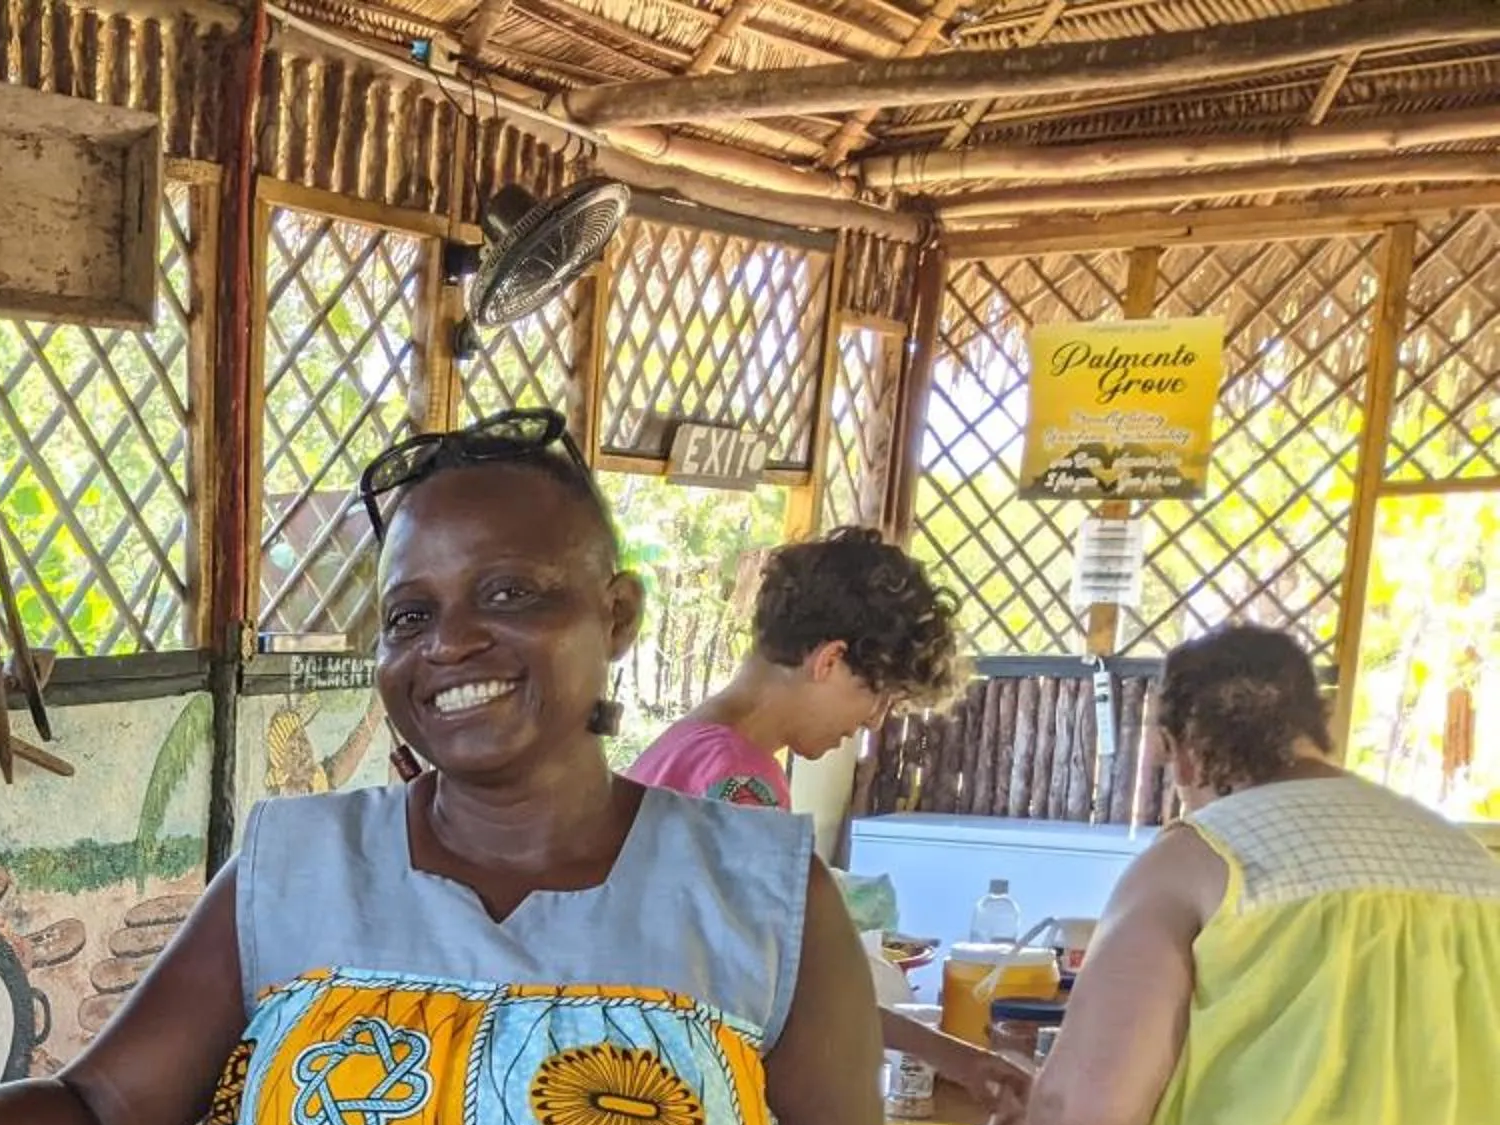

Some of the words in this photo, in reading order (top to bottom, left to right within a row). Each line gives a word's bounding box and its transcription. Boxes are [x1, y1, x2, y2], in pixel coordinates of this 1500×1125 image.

[1051, 340, 1197, 377] Palmento
[1095, 367, 1187, 405] Grove
[682, 425, 758, 478] EXIT
